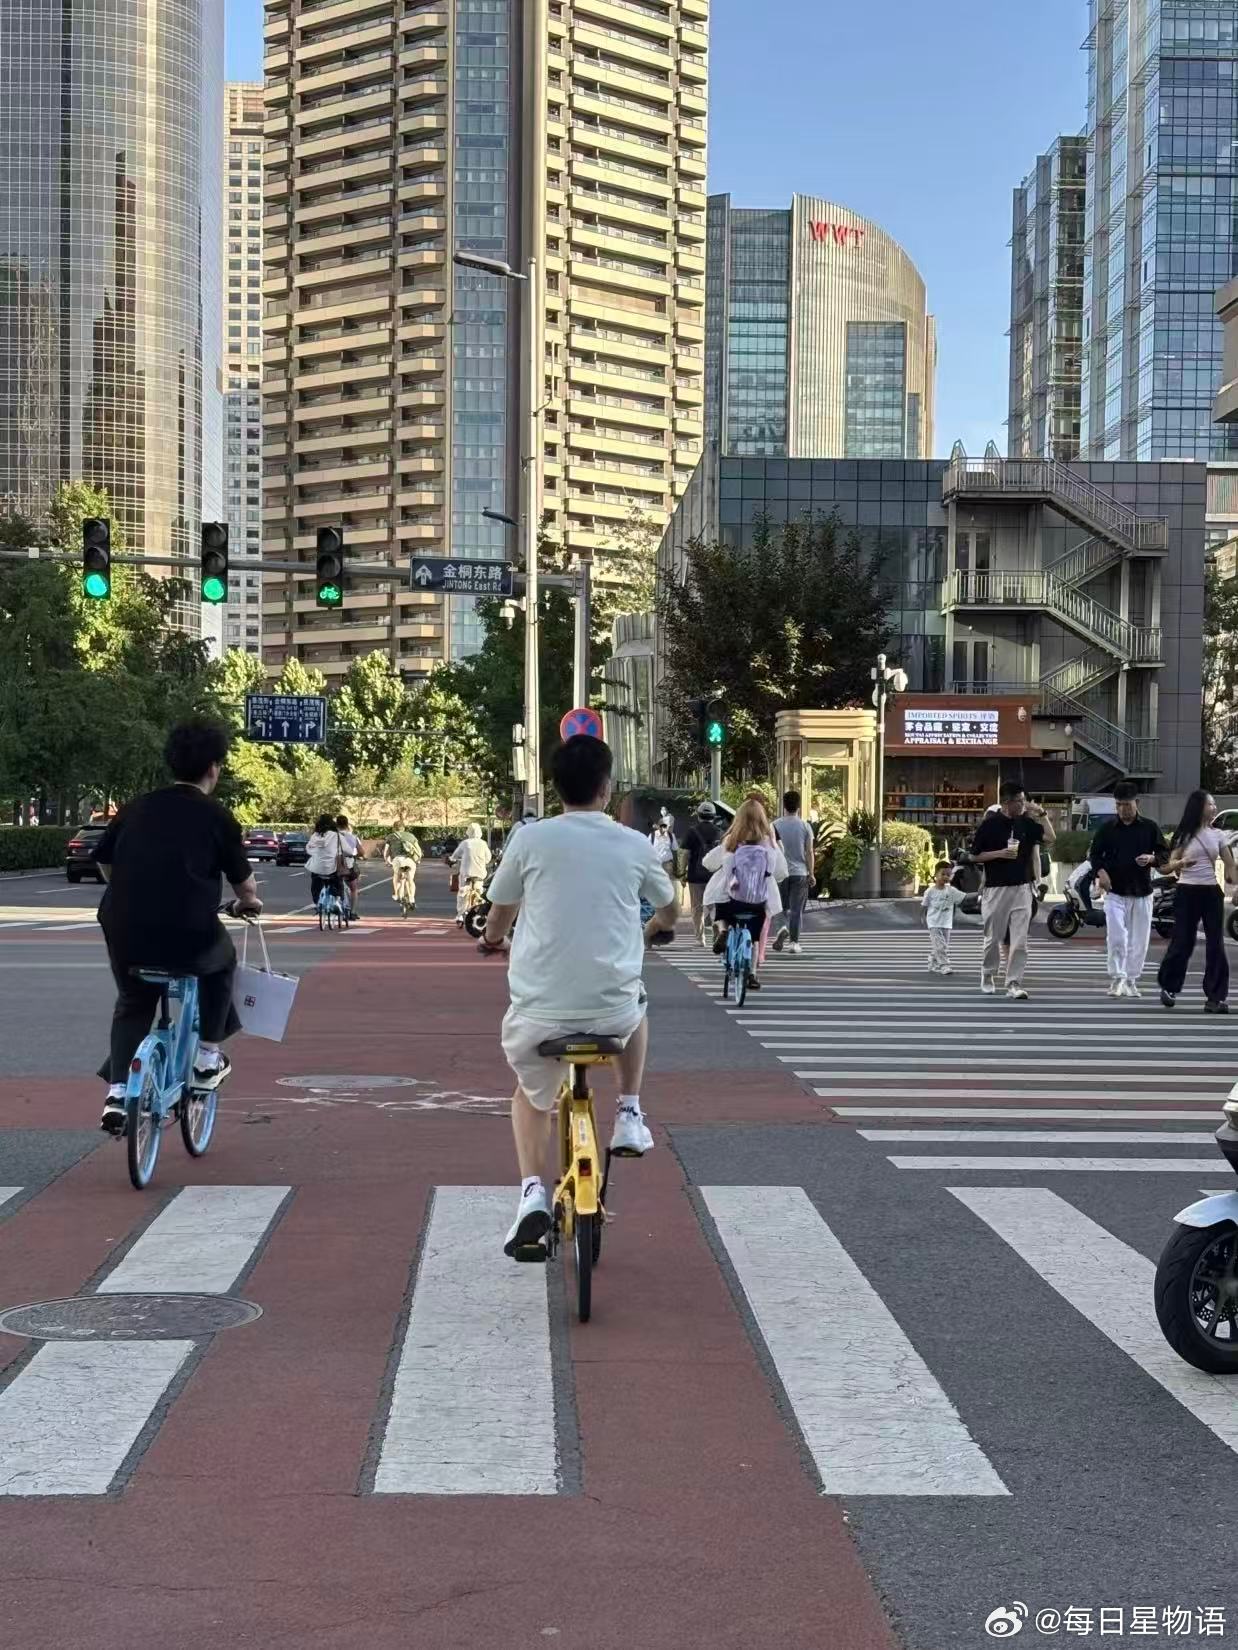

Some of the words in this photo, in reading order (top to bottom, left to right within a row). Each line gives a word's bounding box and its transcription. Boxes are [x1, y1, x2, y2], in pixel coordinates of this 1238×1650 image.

[808, 220, 865, 249] WWT
[442, 563, 503, 581] 金桐东路
[442, 580, 472, 591] JINTONG
[474, 581, 491, 591] East
[493, 582, 502, 592] Rd
[908, 711, 947, 719] IMPORTED
[904, 737, 947, 745] APPRAISAL
